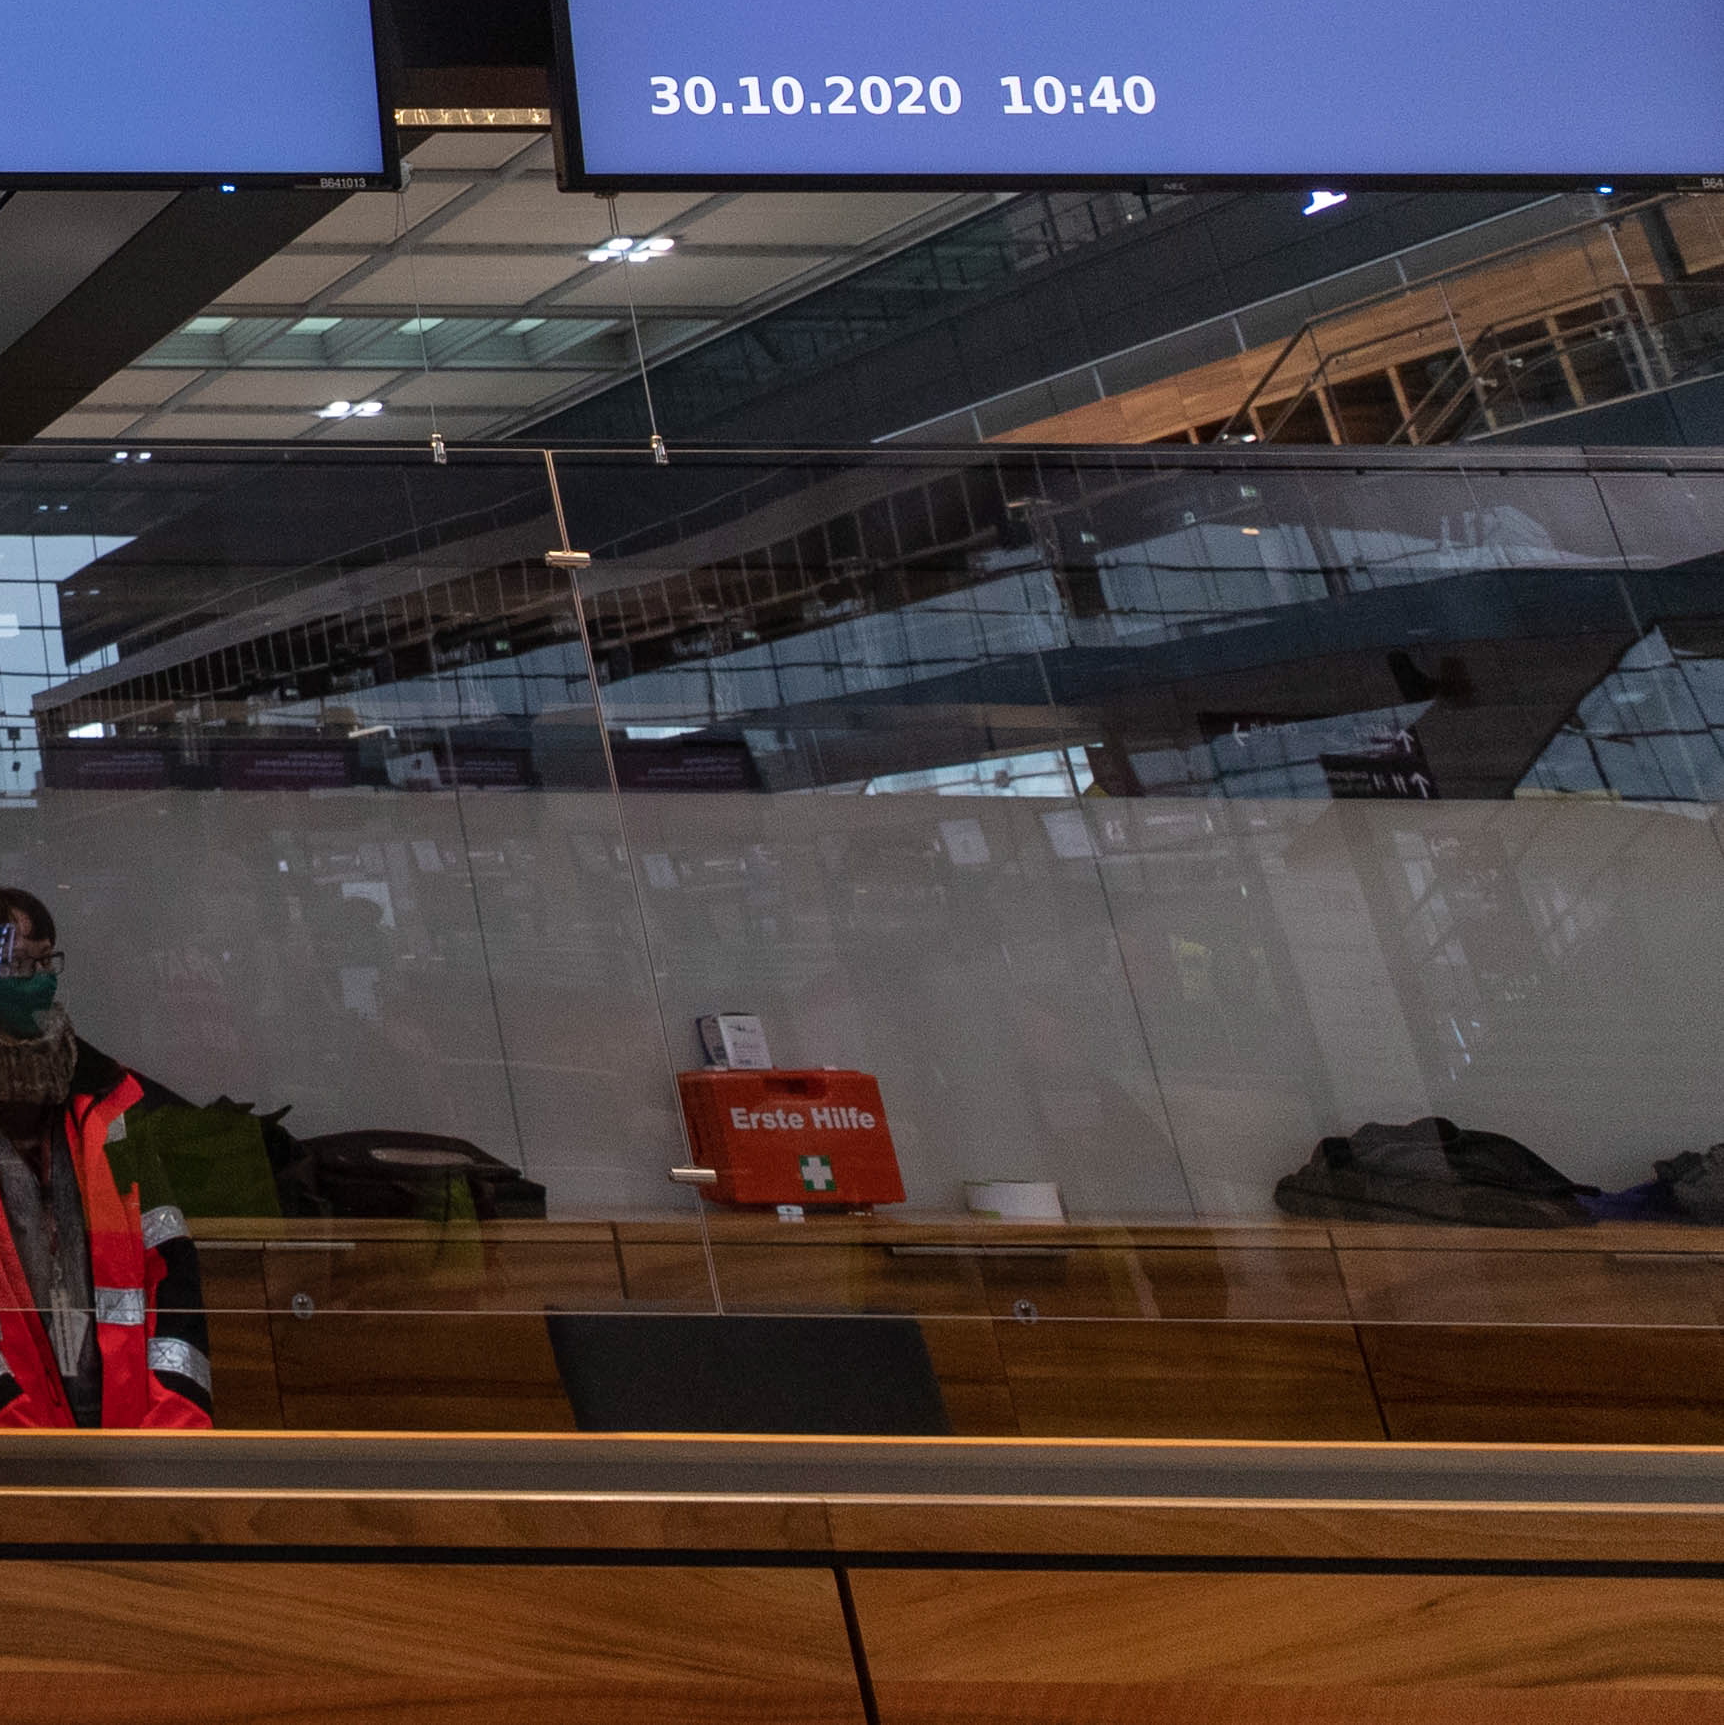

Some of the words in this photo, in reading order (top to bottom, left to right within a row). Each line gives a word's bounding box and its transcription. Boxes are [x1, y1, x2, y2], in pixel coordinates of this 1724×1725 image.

[650, 75, 962, 115] 30.10.2020
[1000, 75, 1156, 115] 10:40
[320, 177, 367, 189] B641013
[1702, 177, 1724, 189] B64
[729, 1106, 805, 1131] Erste
[809, 1106, 877, 1131] Hilfe
